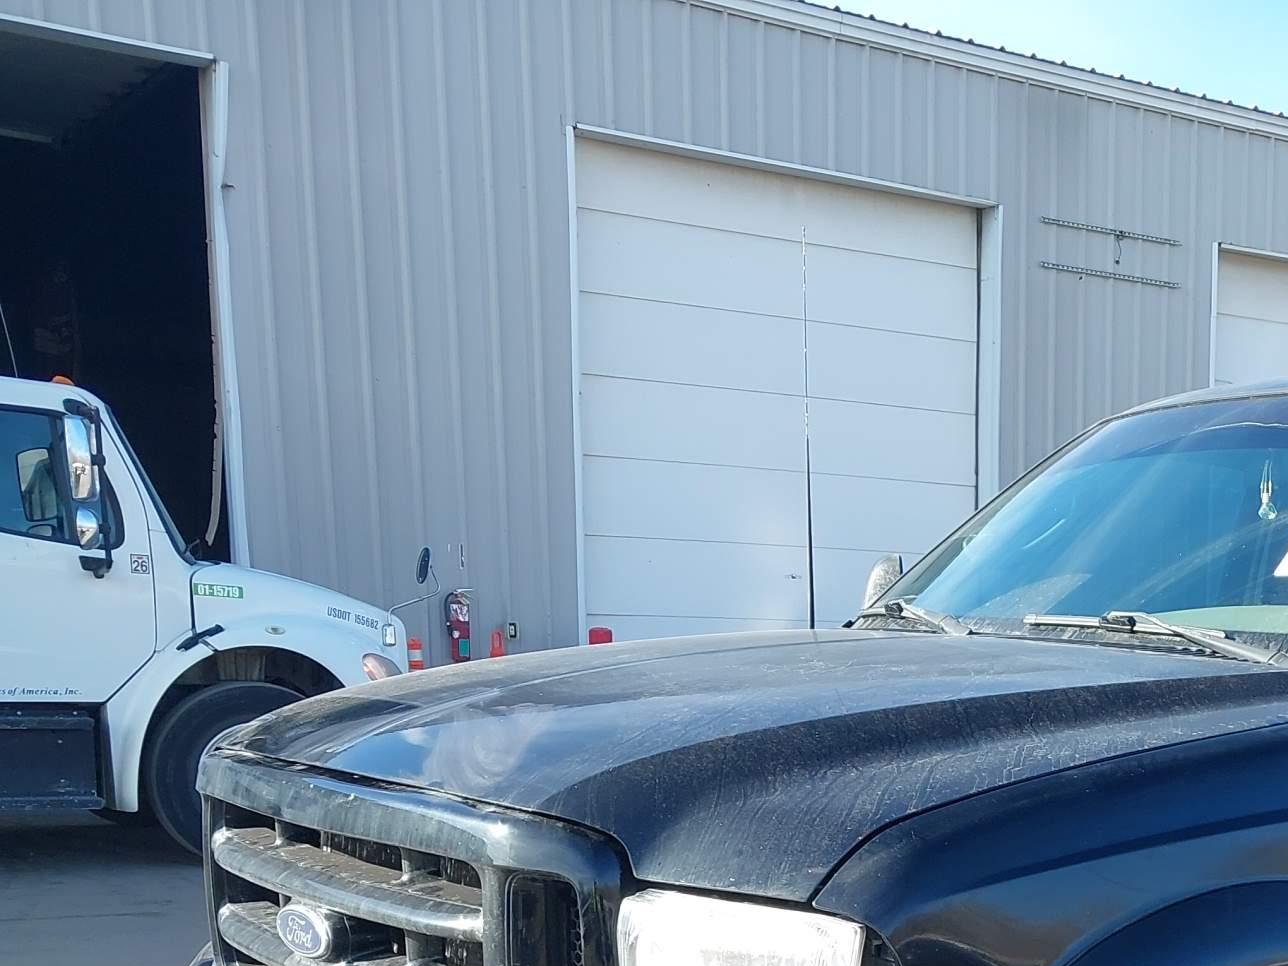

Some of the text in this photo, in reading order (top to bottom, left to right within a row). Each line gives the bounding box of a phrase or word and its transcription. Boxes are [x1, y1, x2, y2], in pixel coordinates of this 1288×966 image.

[132, 559, 148, 573] 26
[197, 584, 240, 598] 01-15719
[327, 606, 379, 631] USDOT 155682
[7, 686, 18, 697] of
[64, 687, 83, 696] Inc.
[286, 915, 313, 948] Ford
